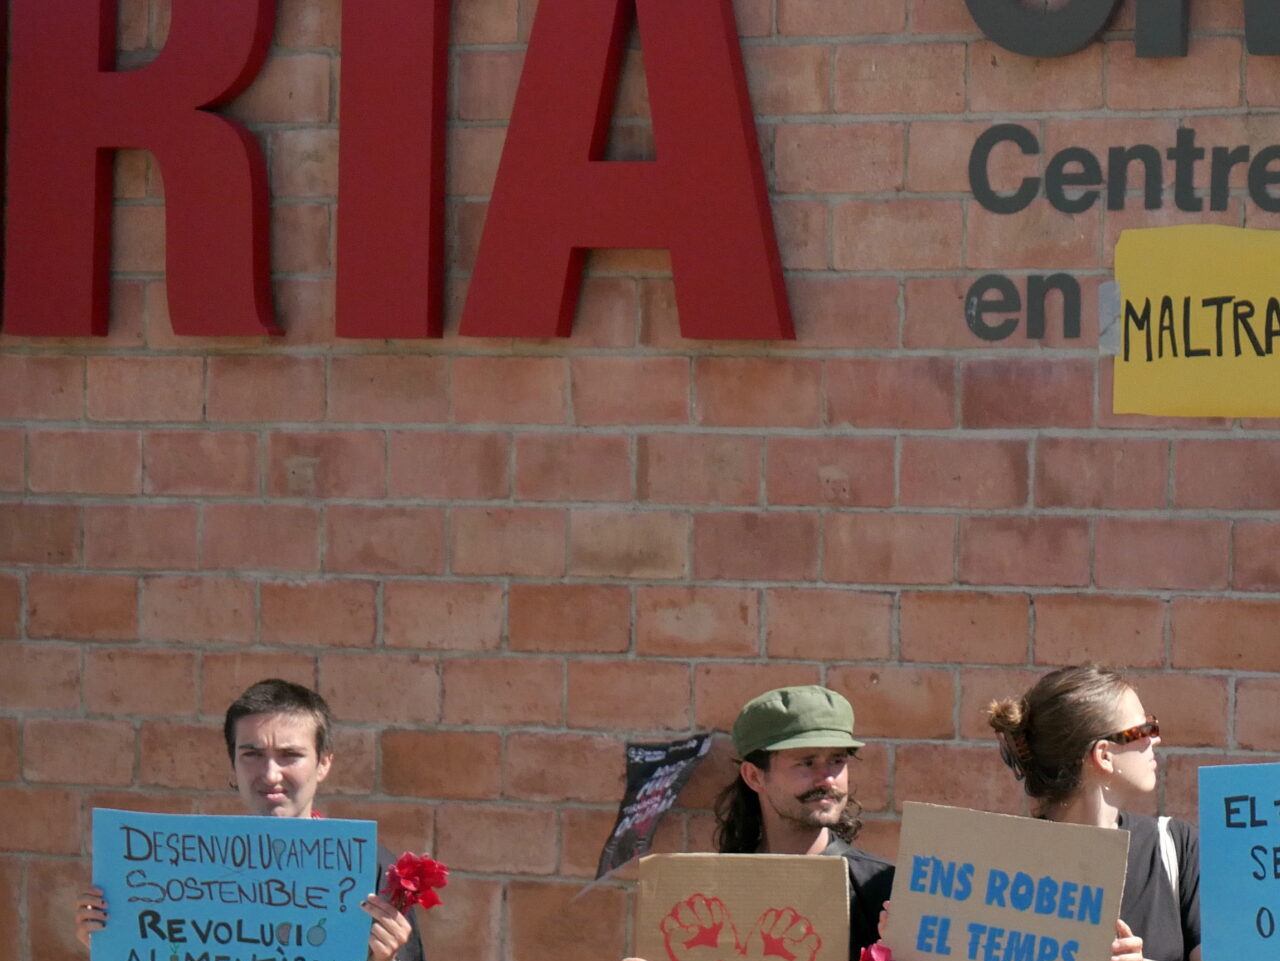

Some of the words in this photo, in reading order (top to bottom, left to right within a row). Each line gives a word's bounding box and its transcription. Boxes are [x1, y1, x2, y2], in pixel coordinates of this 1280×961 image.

[966, 271, 1082, 341] en
[1224, 795, 1268, 828] EL
[120, 826, 367, 874] DESENVOLUPAMENT
[126, 869, 356, 913] SOSTENIBLE?
[909, 855, 975, 901] ENS
[985, 869, 1104, 925] ROBEN
[916, 914, 952, 956] EL
[1256, 906, 1275, 939] O
